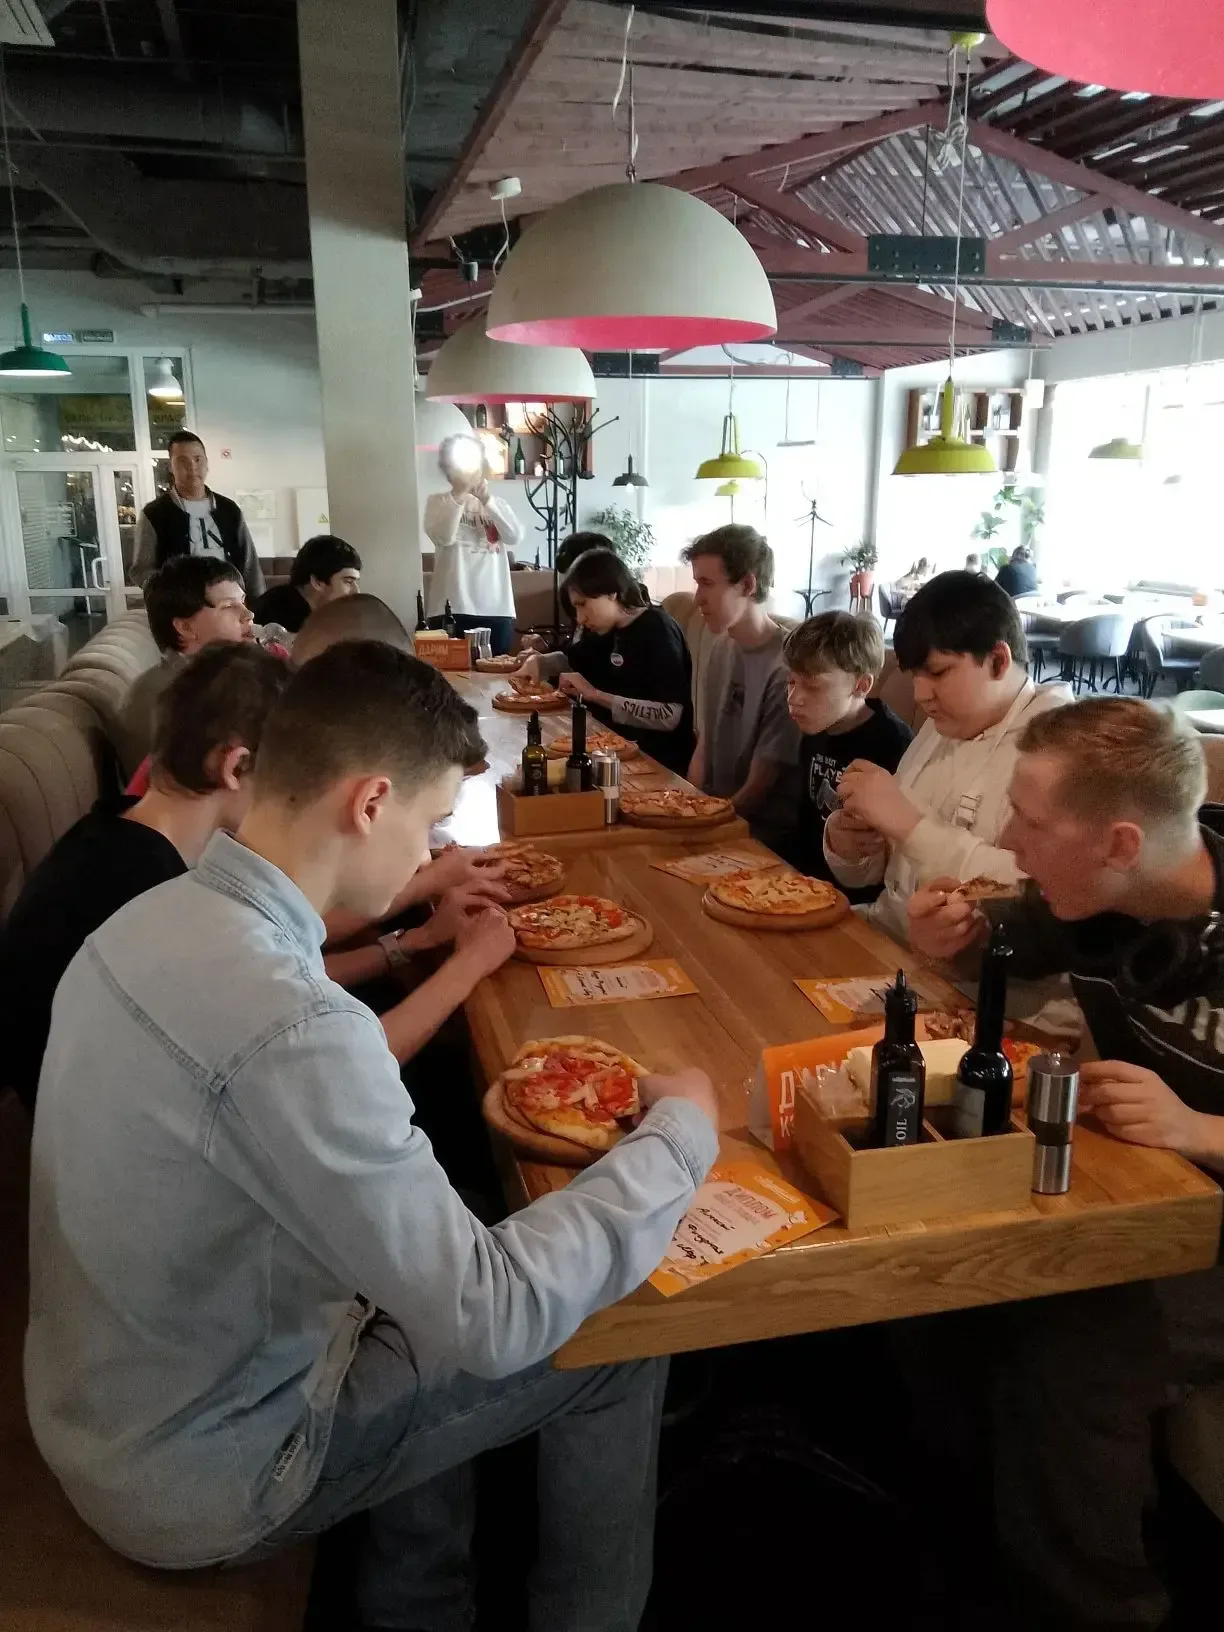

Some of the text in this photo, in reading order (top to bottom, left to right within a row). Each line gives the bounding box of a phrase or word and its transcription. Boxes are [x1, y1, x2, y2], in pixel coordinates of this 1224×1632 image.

[622, 700, 674, 720] ATHLETICS
[895, 1118, 908, 1141] OIL
[722, 1187, 778, 1220] ДИПЛОМ
